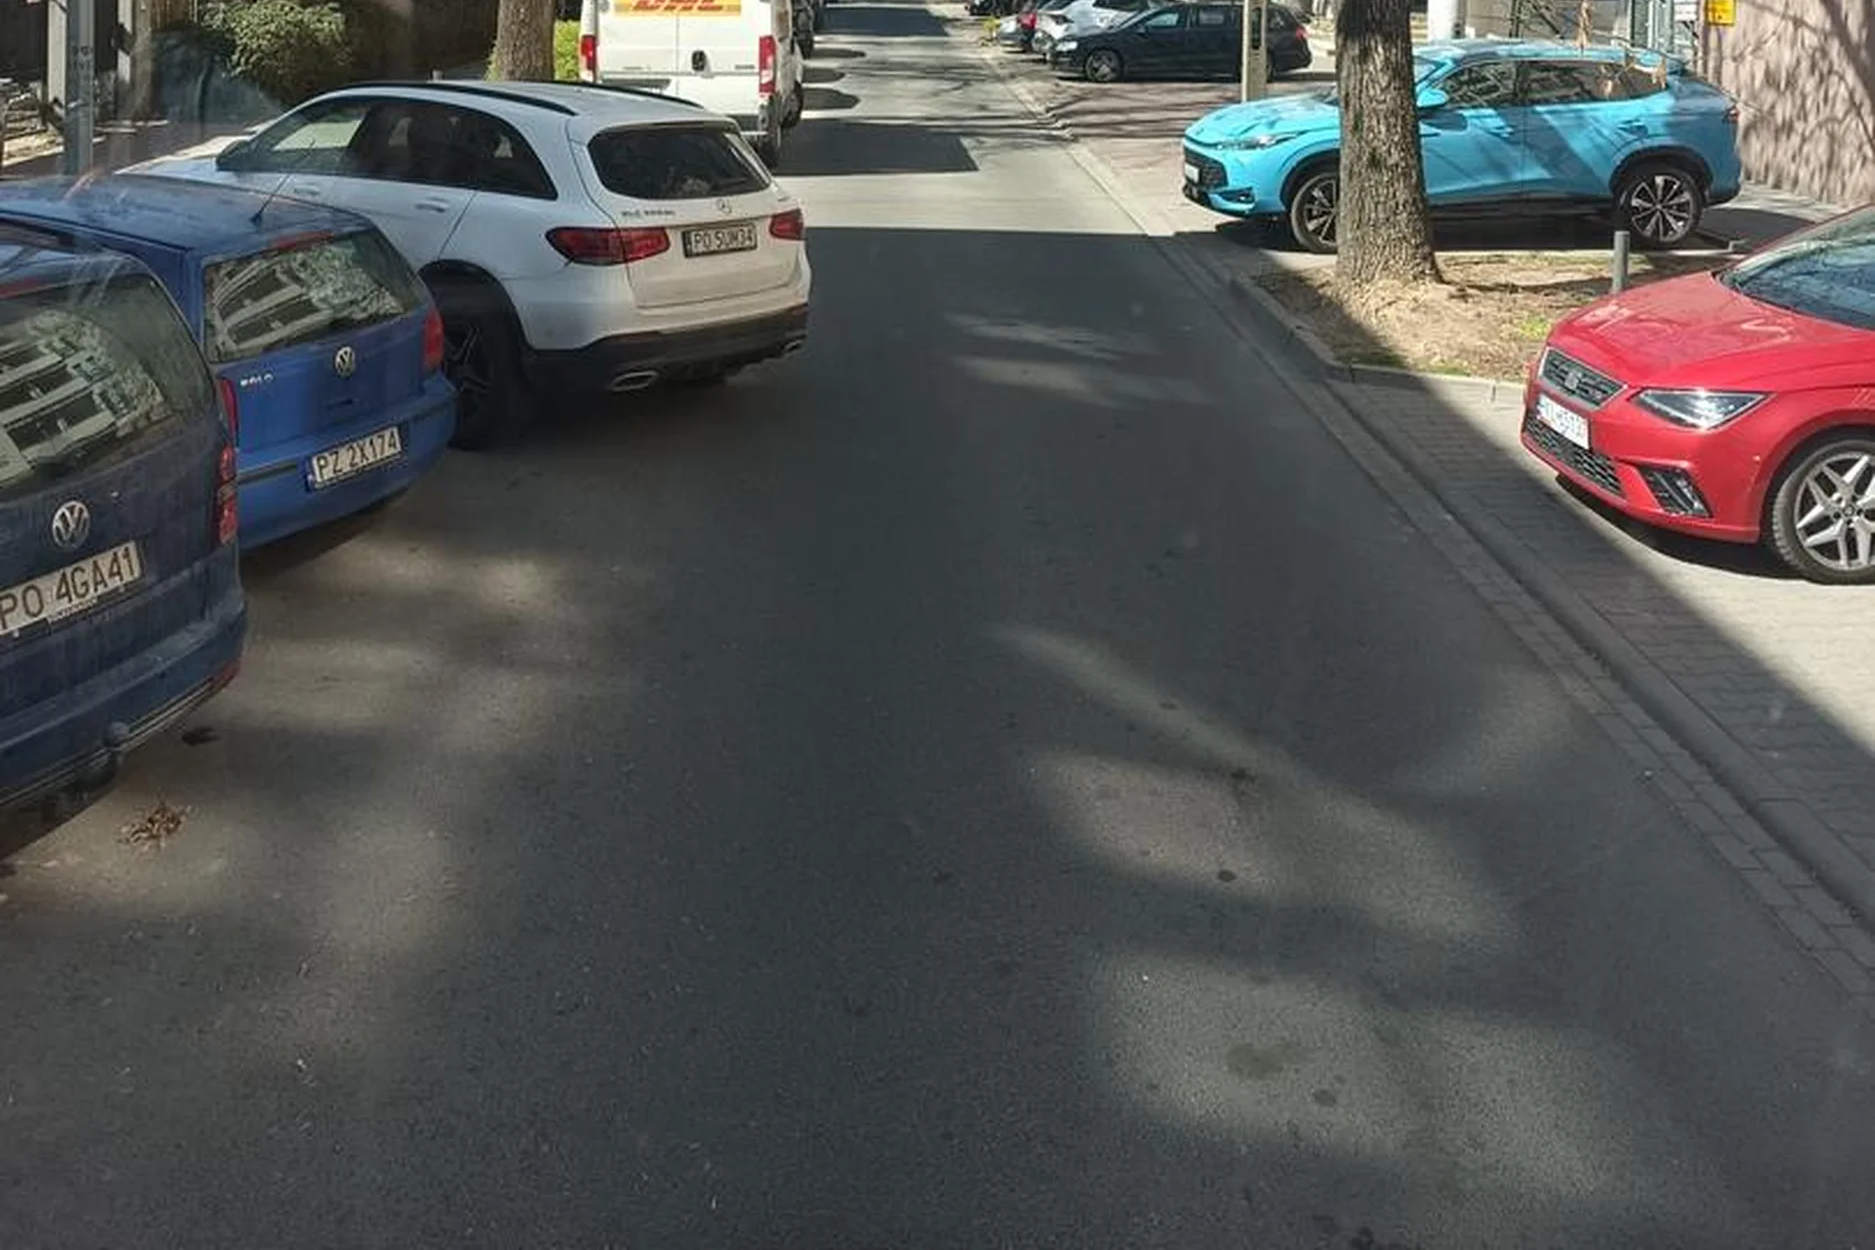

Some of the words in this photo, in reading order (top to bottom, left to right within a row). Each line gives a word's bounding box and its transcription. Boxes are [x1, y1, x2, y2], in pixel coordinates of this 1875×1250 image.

[694, 232, 711, 250] PO
[316, 450, 343, 480] PZ
[347, 430, 398, 468] 2X174
[0, 584, 44, 630] PO
[55, 547, 135, 604] 4GA41
